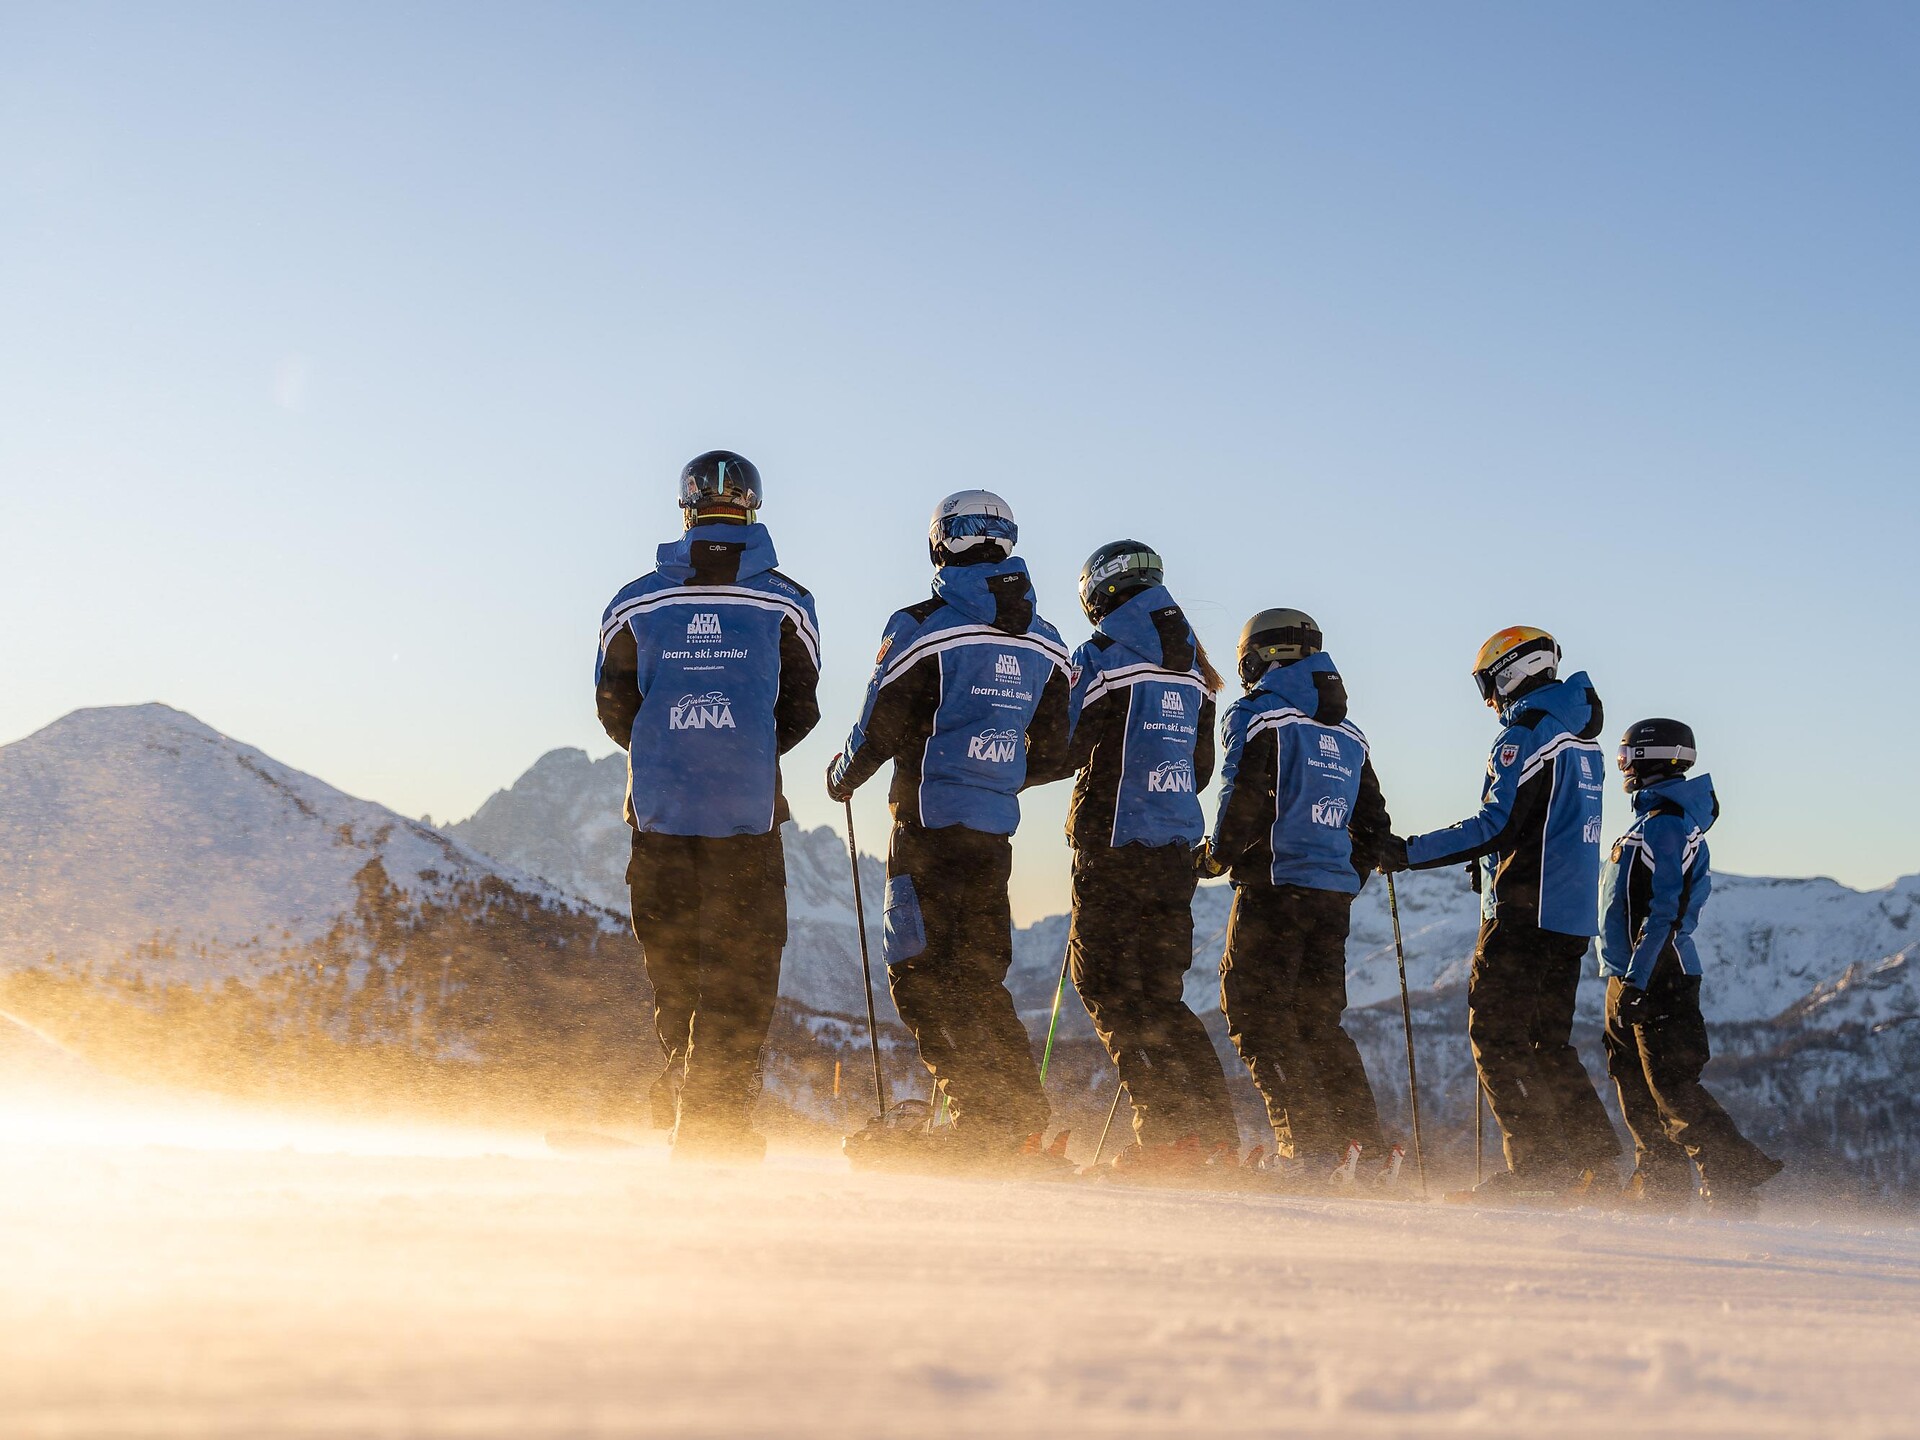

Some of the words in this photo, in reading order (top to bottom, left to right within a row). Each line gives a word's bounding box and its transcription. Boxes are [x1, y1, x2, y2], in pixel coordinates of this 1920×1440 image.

[691, 613, 719, 624] ALTA
[687, 623, 722, 634] BADIA
[662, 649, 693, 660] learn.
[694, 648, 712, 659] ski.
[713, 648, 748, 659] smile!
[998, 653, 1018, 665] ALTA
[995, 662, 1021, 676] BADIA
[1488, 651, 1518, 676] HEAD
[971, 685, 1001, 696] learn.
[1001, 688, 1015, 698] ski.
[1163, 690, 1182, 701] ALTA
[1161, 699, 1184, 711] BADIA
[669, 705, 736, 730] RANA
[1167, 723, 1179, 732] ski.
[967, 736, 1016, 763] RANA
[1148, 771, 1193, 793] RANA
